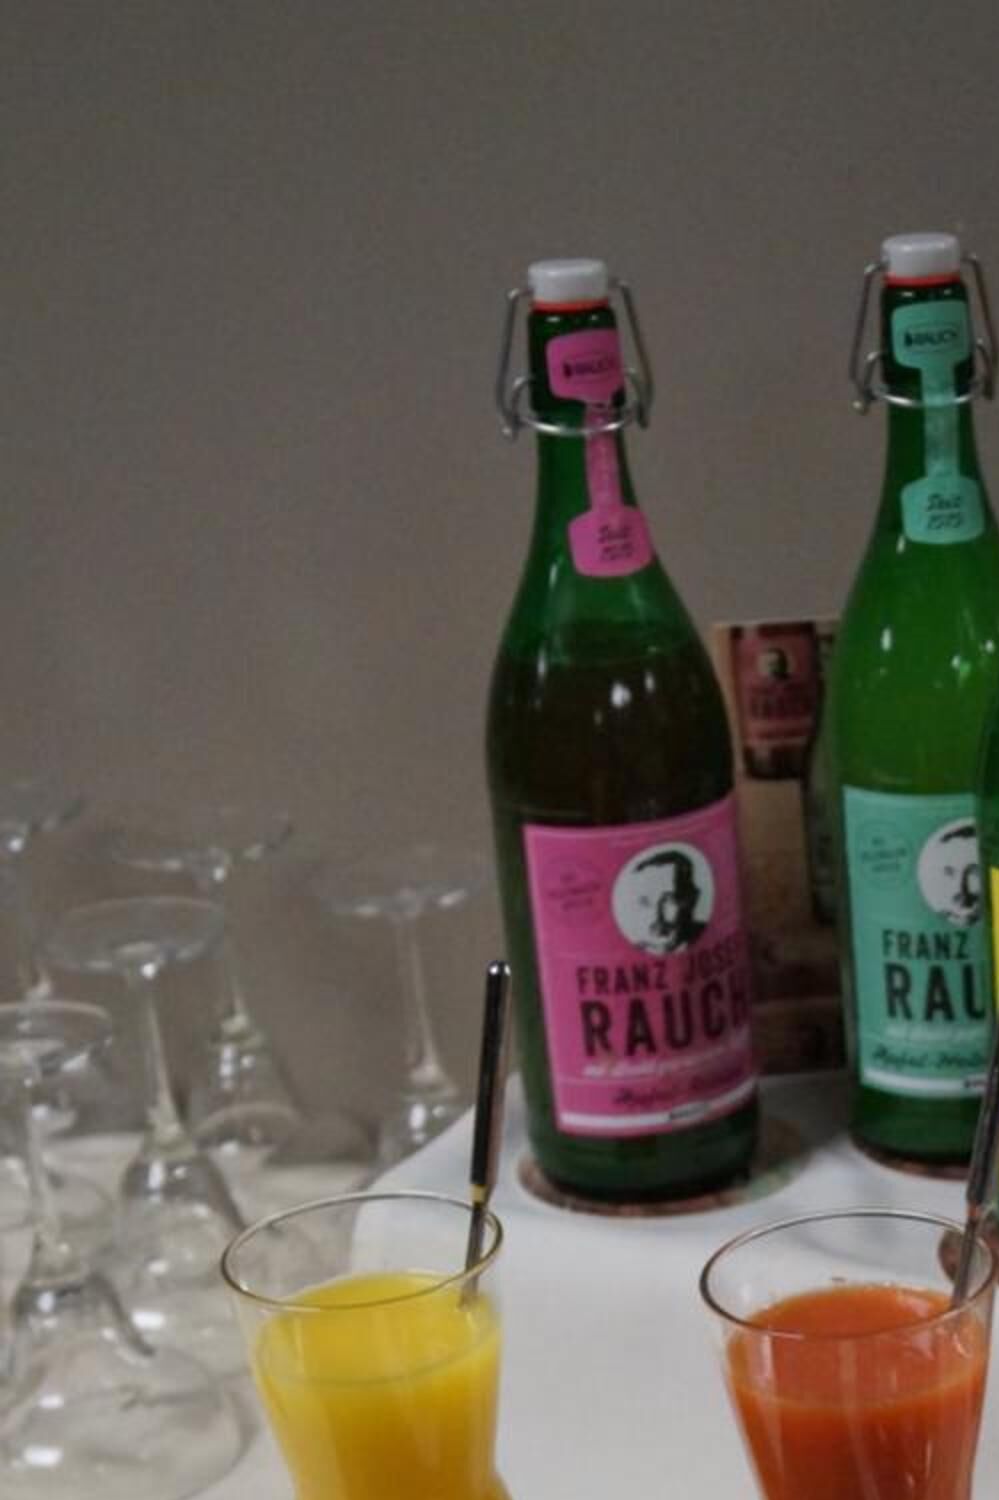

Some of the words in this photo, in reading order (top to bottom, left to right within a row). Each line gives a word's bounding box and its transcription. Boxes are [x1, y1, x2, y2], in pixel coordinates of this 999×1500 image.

[881, 928, 970, 961] FRANZ
[576, 960, 668, 995] FRANZ
[884, 962, 985, 1022] RAU
